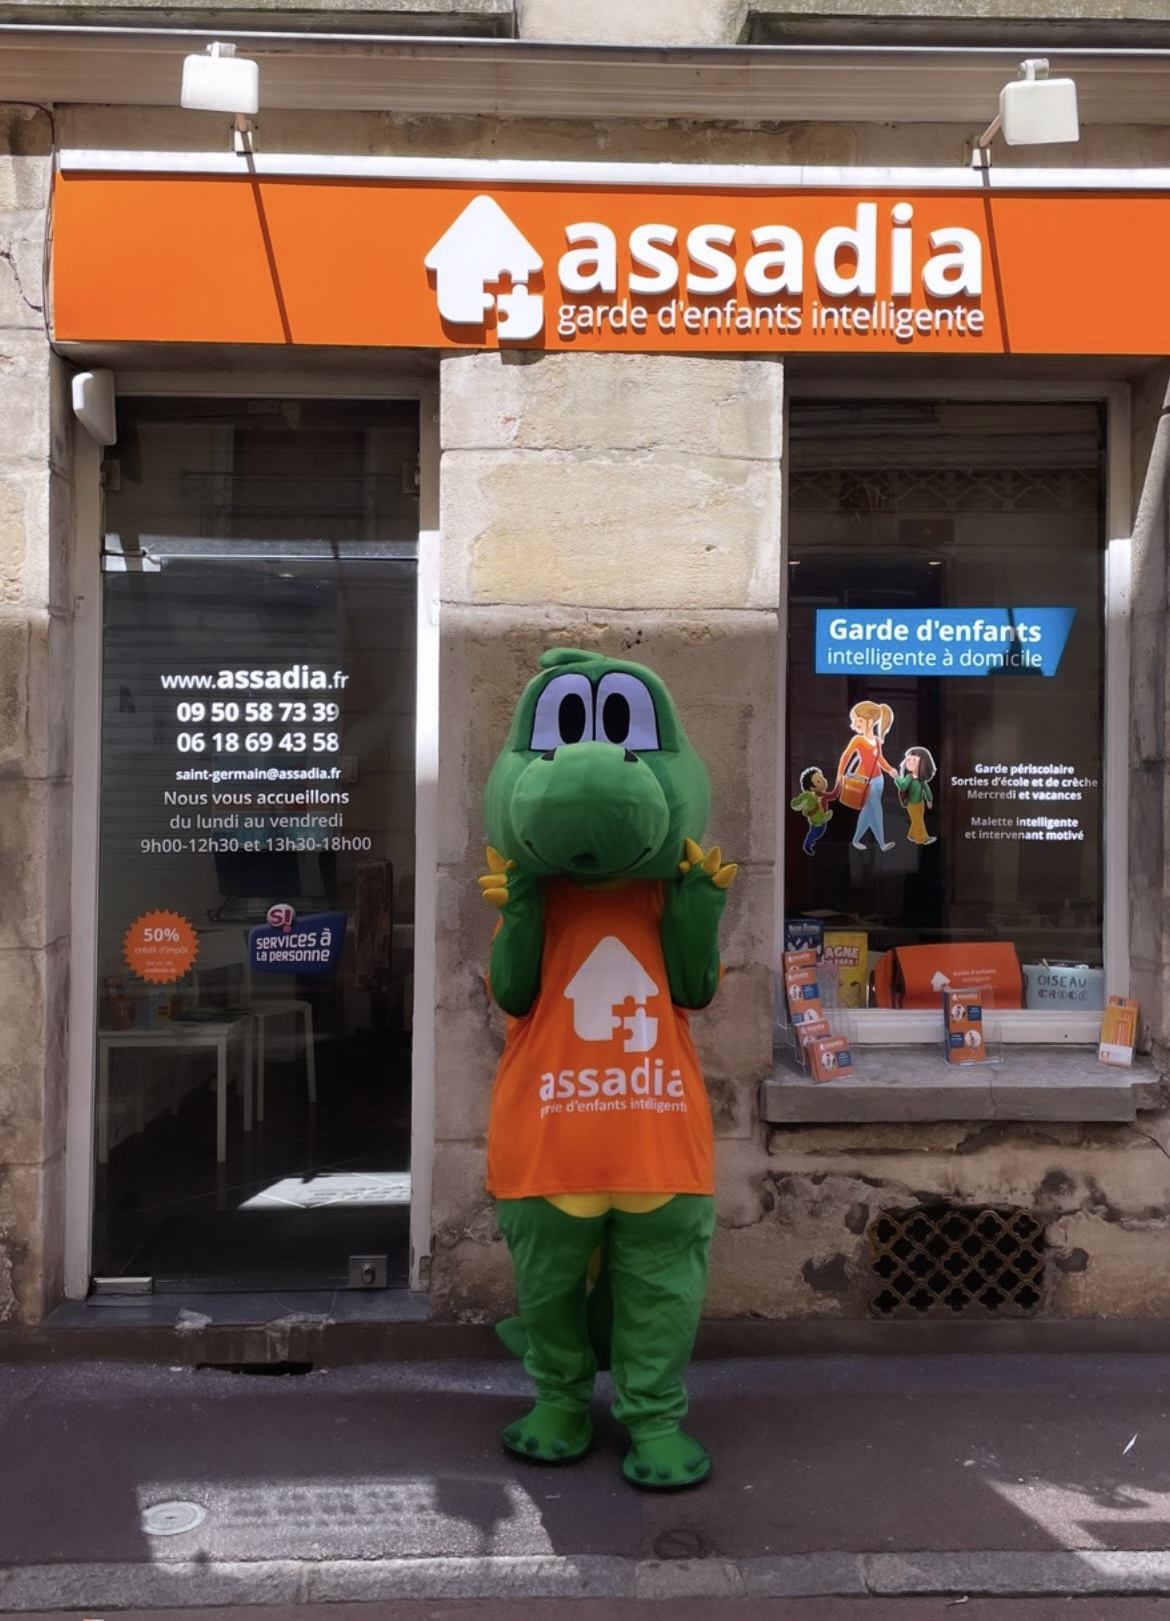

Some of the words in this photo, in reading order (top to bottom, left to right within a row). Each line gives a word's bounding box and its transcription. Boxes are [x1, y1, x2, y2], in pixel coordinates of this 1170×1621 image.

[557, 202, 983, 298] assadia
[557, 300, 648, 335] garde
[657, 300, 801, 330] d'enfants
[811, 302, 985, 338] intelligente
[829, 618, 909, 641] Garde
[916, 619, 1042, 642] d'enfants
[827, 648, 936, 670] intelligente
[943, 649, 953, 667] à
[959, 649, 1042, 667] domicile
[161, 664, 349, 690] www.assadia.fr
[177, 702, 205, 722] 09
[211, 702, 239, 722] 50
[245, 702, 273, 722] 58
[279, 702, 306, 722] 73
[312, 702, 340, 722] 39
[177, 732, 205, 752] 06
[212, 732, 239, 752] 18
[245, 732, 273, 752] 69
[278, 732, 306, 752] 43
[312, 732, 339, 752] 58
[176, 767, 342, 783] saint-germain@assadia.fr
[975, 764, 1008, 774] Garde
[1010, 764, 1075, 776] périscolaire
[951, 776, 989, 786] Sorties
[991, 777, 1029, 786] d'école
[1031, 777, 1043, 787] et
[1045, 777, 1059, 787] de
[1061, 777, 1099, 787] crèche
[164, 791, 208, 806] Nous
[212, 793, 252, 805] vous
[257, 789, 350, 805] accueillons
[967, 790, 1017, 800] Mercredi
[1018, 790, 1030, 800] et
[1032, 791, 1082, 800] vacances
[169, 814, 191, 829] du
[196, 814, 239, 829] lundi
[244, 816, 265, 828] au
[269, 813, 343, 828] vendredi
[971, 817, 1013, 827] Malette
[1016, 817, 1079, 830] intelligente
[965, 831, 976, 839] et
[979, 830, 1043, 840] intervenant
[1045, 829, 1084, 840] motivé
[141, 838, 239, 853] 9h00-12h30
[243, 839, 260, 851] et
[265, 836, 371, 851] 13h30-18h00
[143, 927, 180, 943] 50%
[320, 927, 331, 946] à
[1038, 975, 1087, 988] OISEAU
[539, 1057, 684, 1101] assadia
[566, 1099, 626, 1112] d'enfants
